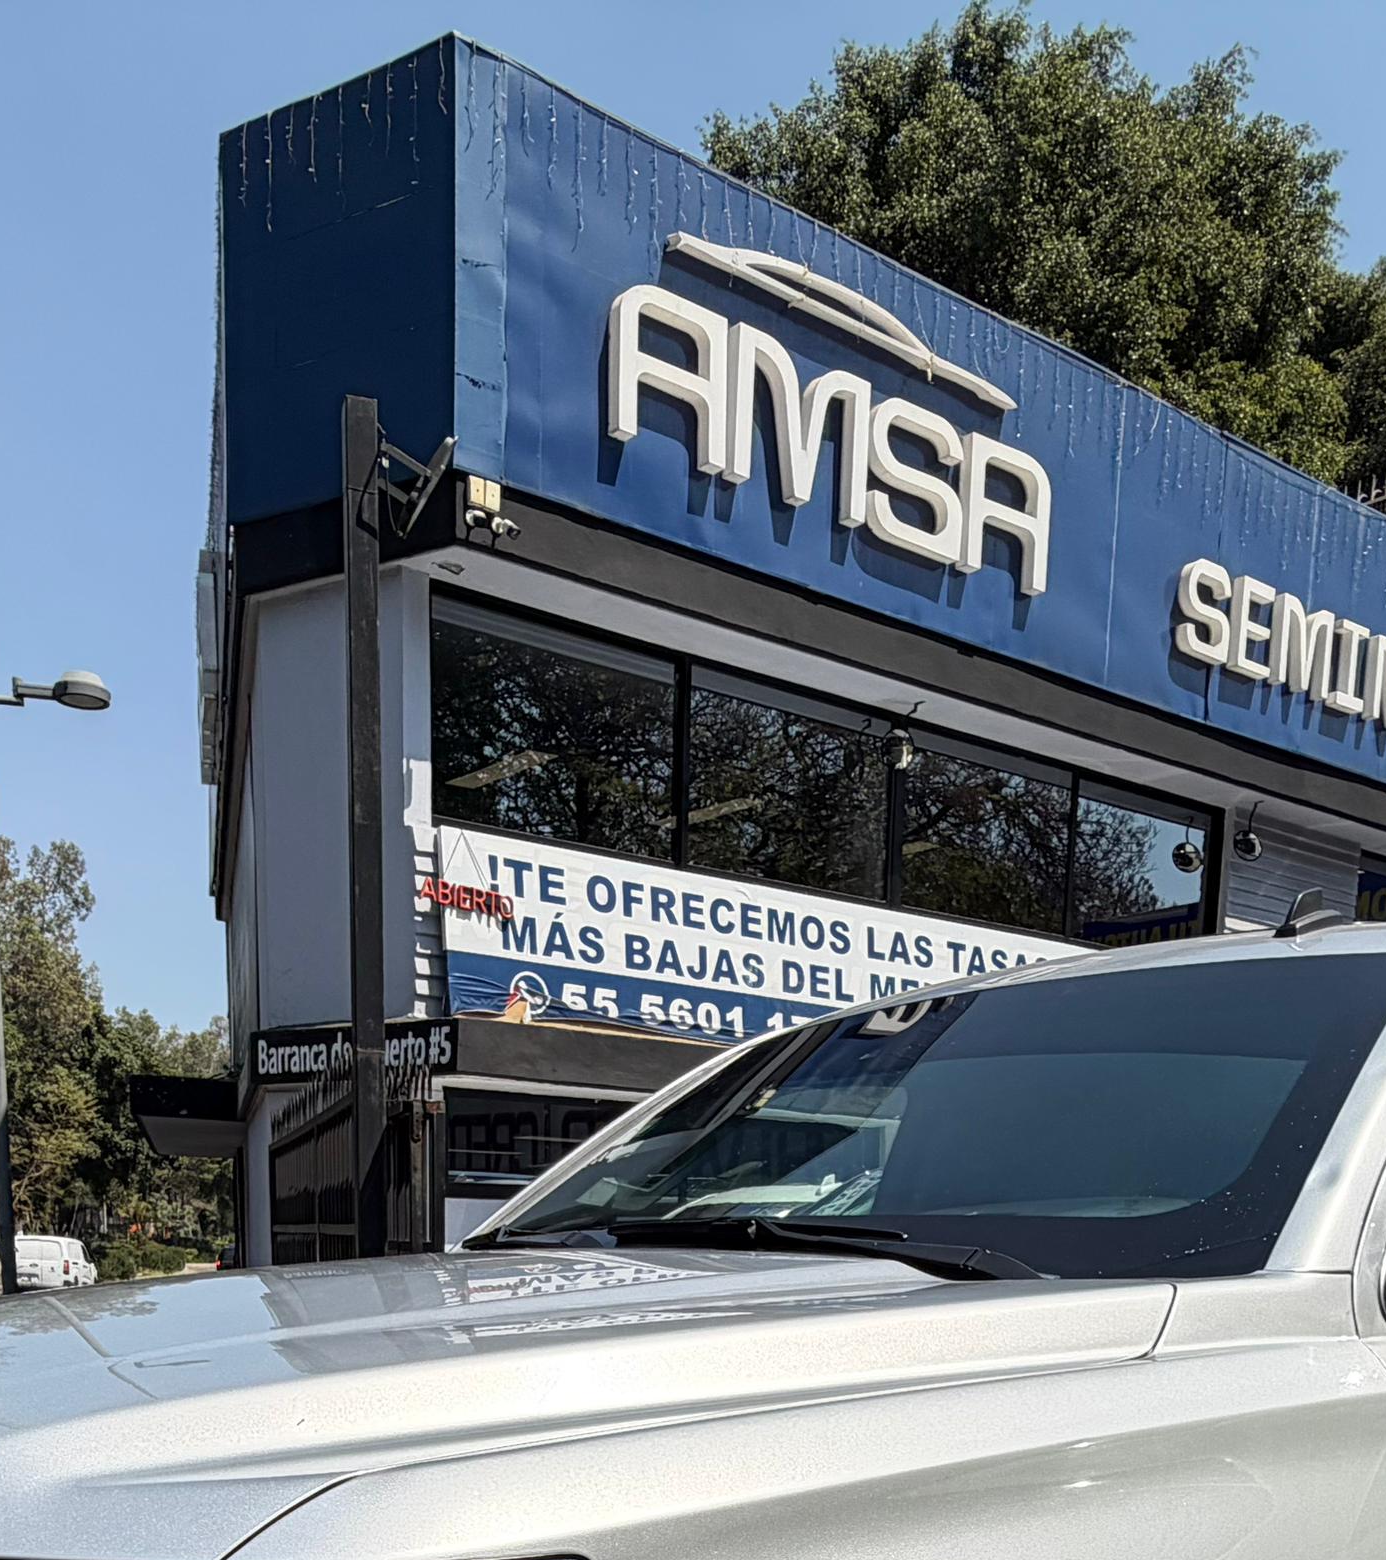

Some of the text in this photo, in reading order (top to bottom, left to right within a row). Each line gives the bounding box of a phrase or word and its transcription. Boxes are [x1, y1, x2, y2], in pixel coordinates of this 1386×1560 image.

[608, 284, 1052, 597] AMSA
[419, 874, 514, 920] ABIERTO
[585, 875, 851, 955] OFRECEMOS
[867, 925, 934, 968] LAS
[946, 941, 1048, 976] TAS
[502, 912, 605, 964] MÁS
[624, 933, 765, 988] BAJAS
[782, 959, 855, 1003] DEL
[562, 983, 619, 1018] 55
[640, 994, 746, 1038] 5601
[258, 1039, 327, 1075] Barranca
[429, 1026, 452, 1064] #5
